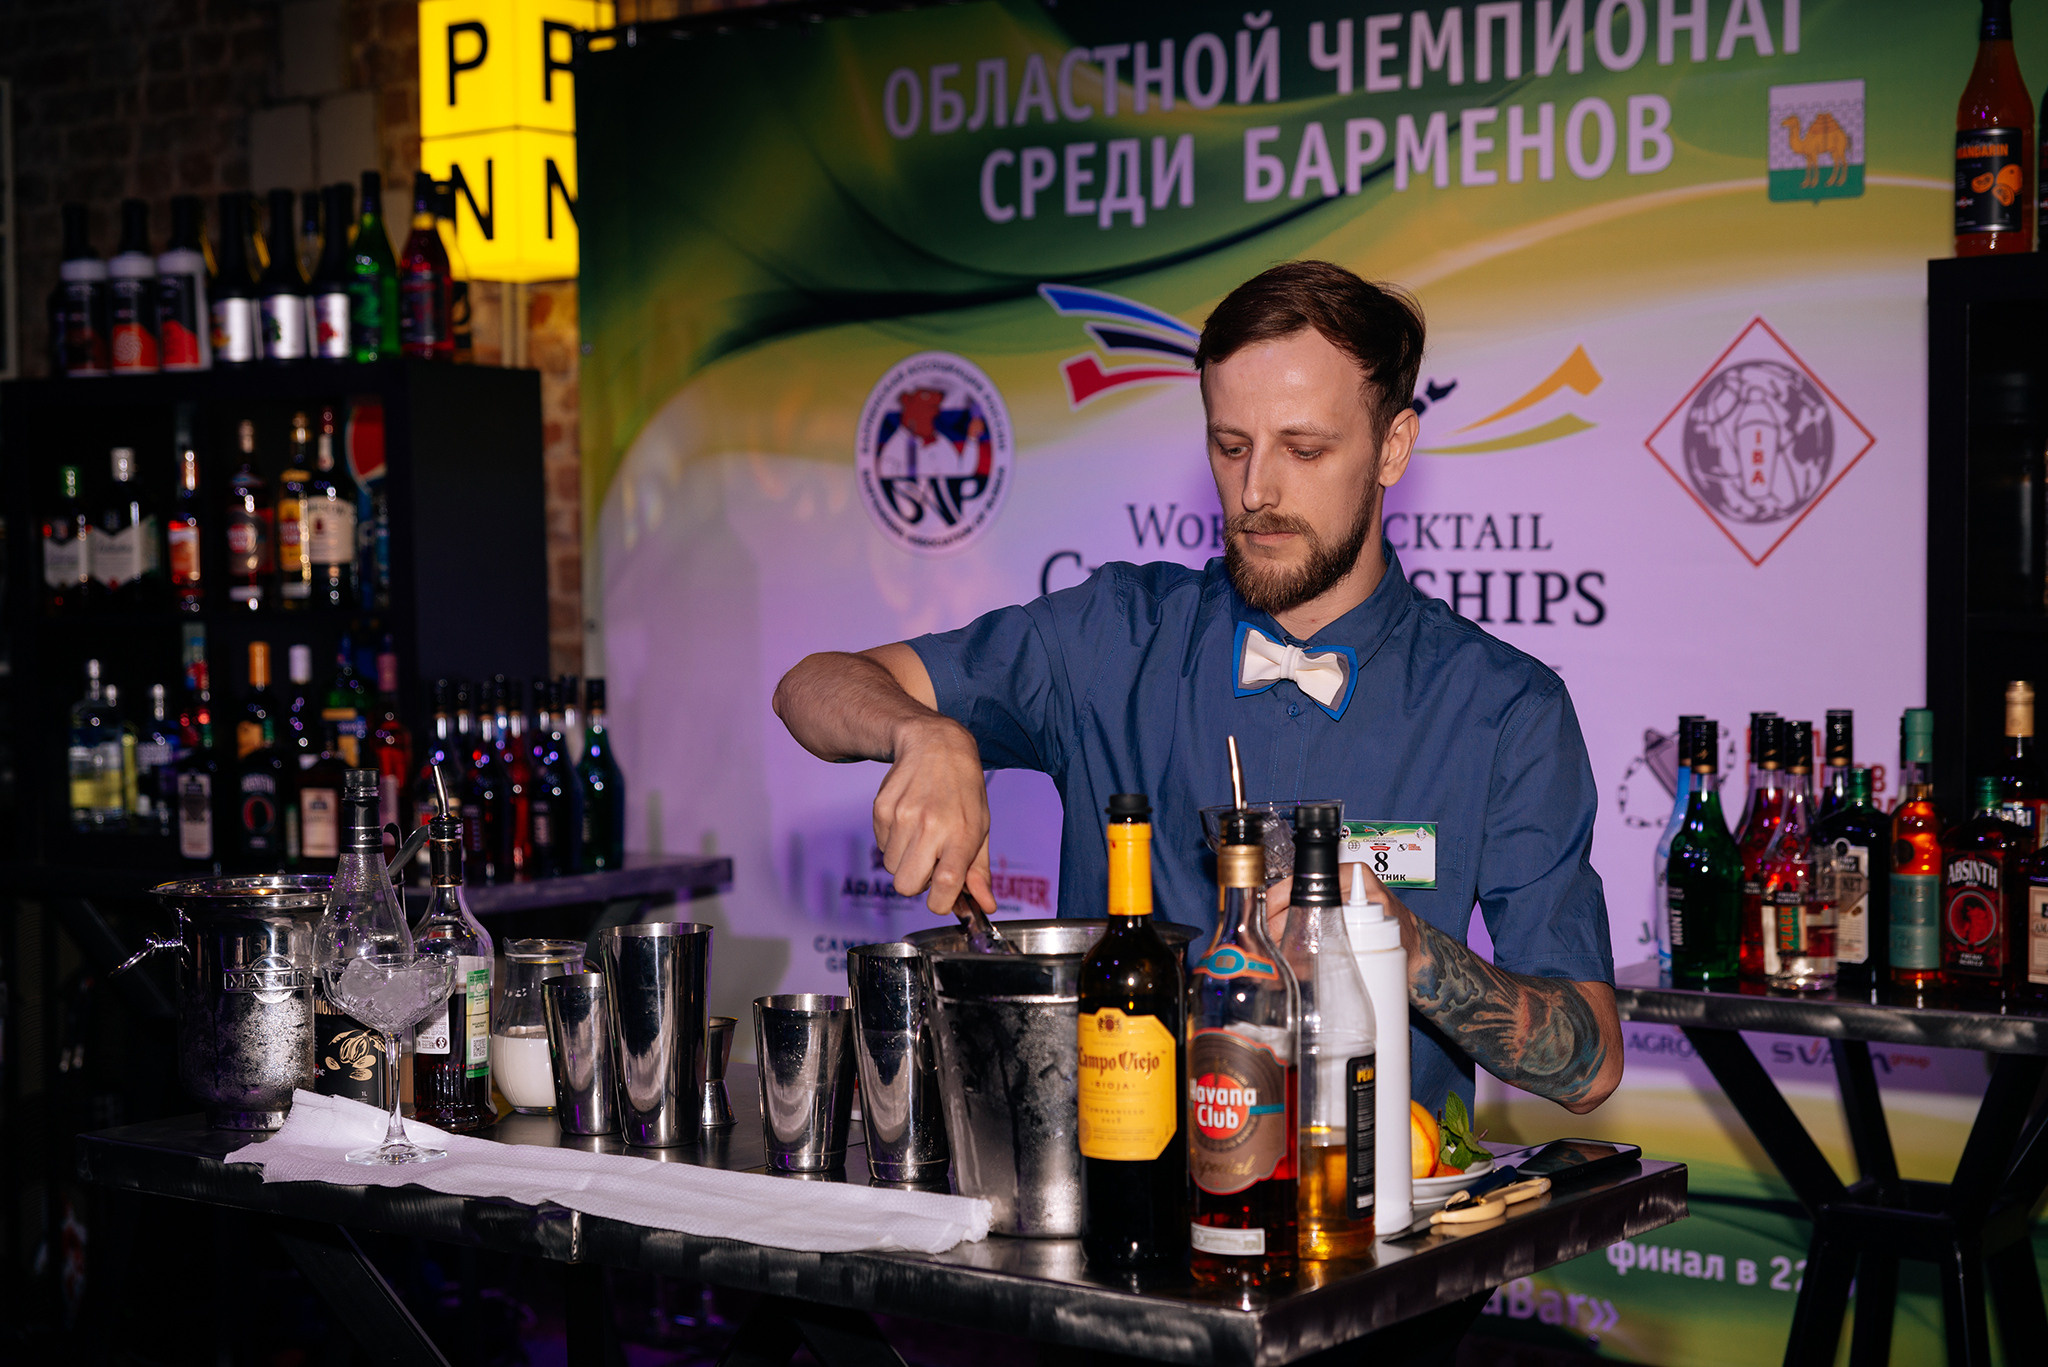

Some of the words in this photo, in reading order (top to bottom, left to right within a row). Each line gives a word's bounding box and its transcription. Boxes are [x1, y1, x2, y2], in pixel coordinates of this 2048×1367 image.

[883, 11, 1280, 139] ОБЛАСТНОЙ
[979, 133, 1195, 229] СРЕДИ
[1244, 93, 1674, 203] БАРМЕНОВ
[1383, 513, 1553, 551] CKTAIL
[1374, 851, 1389, 873] 8
[1948, 859, 1998, 889] ABSINTH
[1779, 906, 1794, 951] PEACH
[229, 970, 312, 988] MARTIN
[314, 999, 345, 1016] LMOND
[1118, 1051, 1160, 1078] Viejo
[1190, 1078, 1257, 1107] Havana
[1197, 1103, 1240, 1129] Club
[1606, 1239, 1725, 1283] финал
[1736, 1258, 1759, 1286] в
